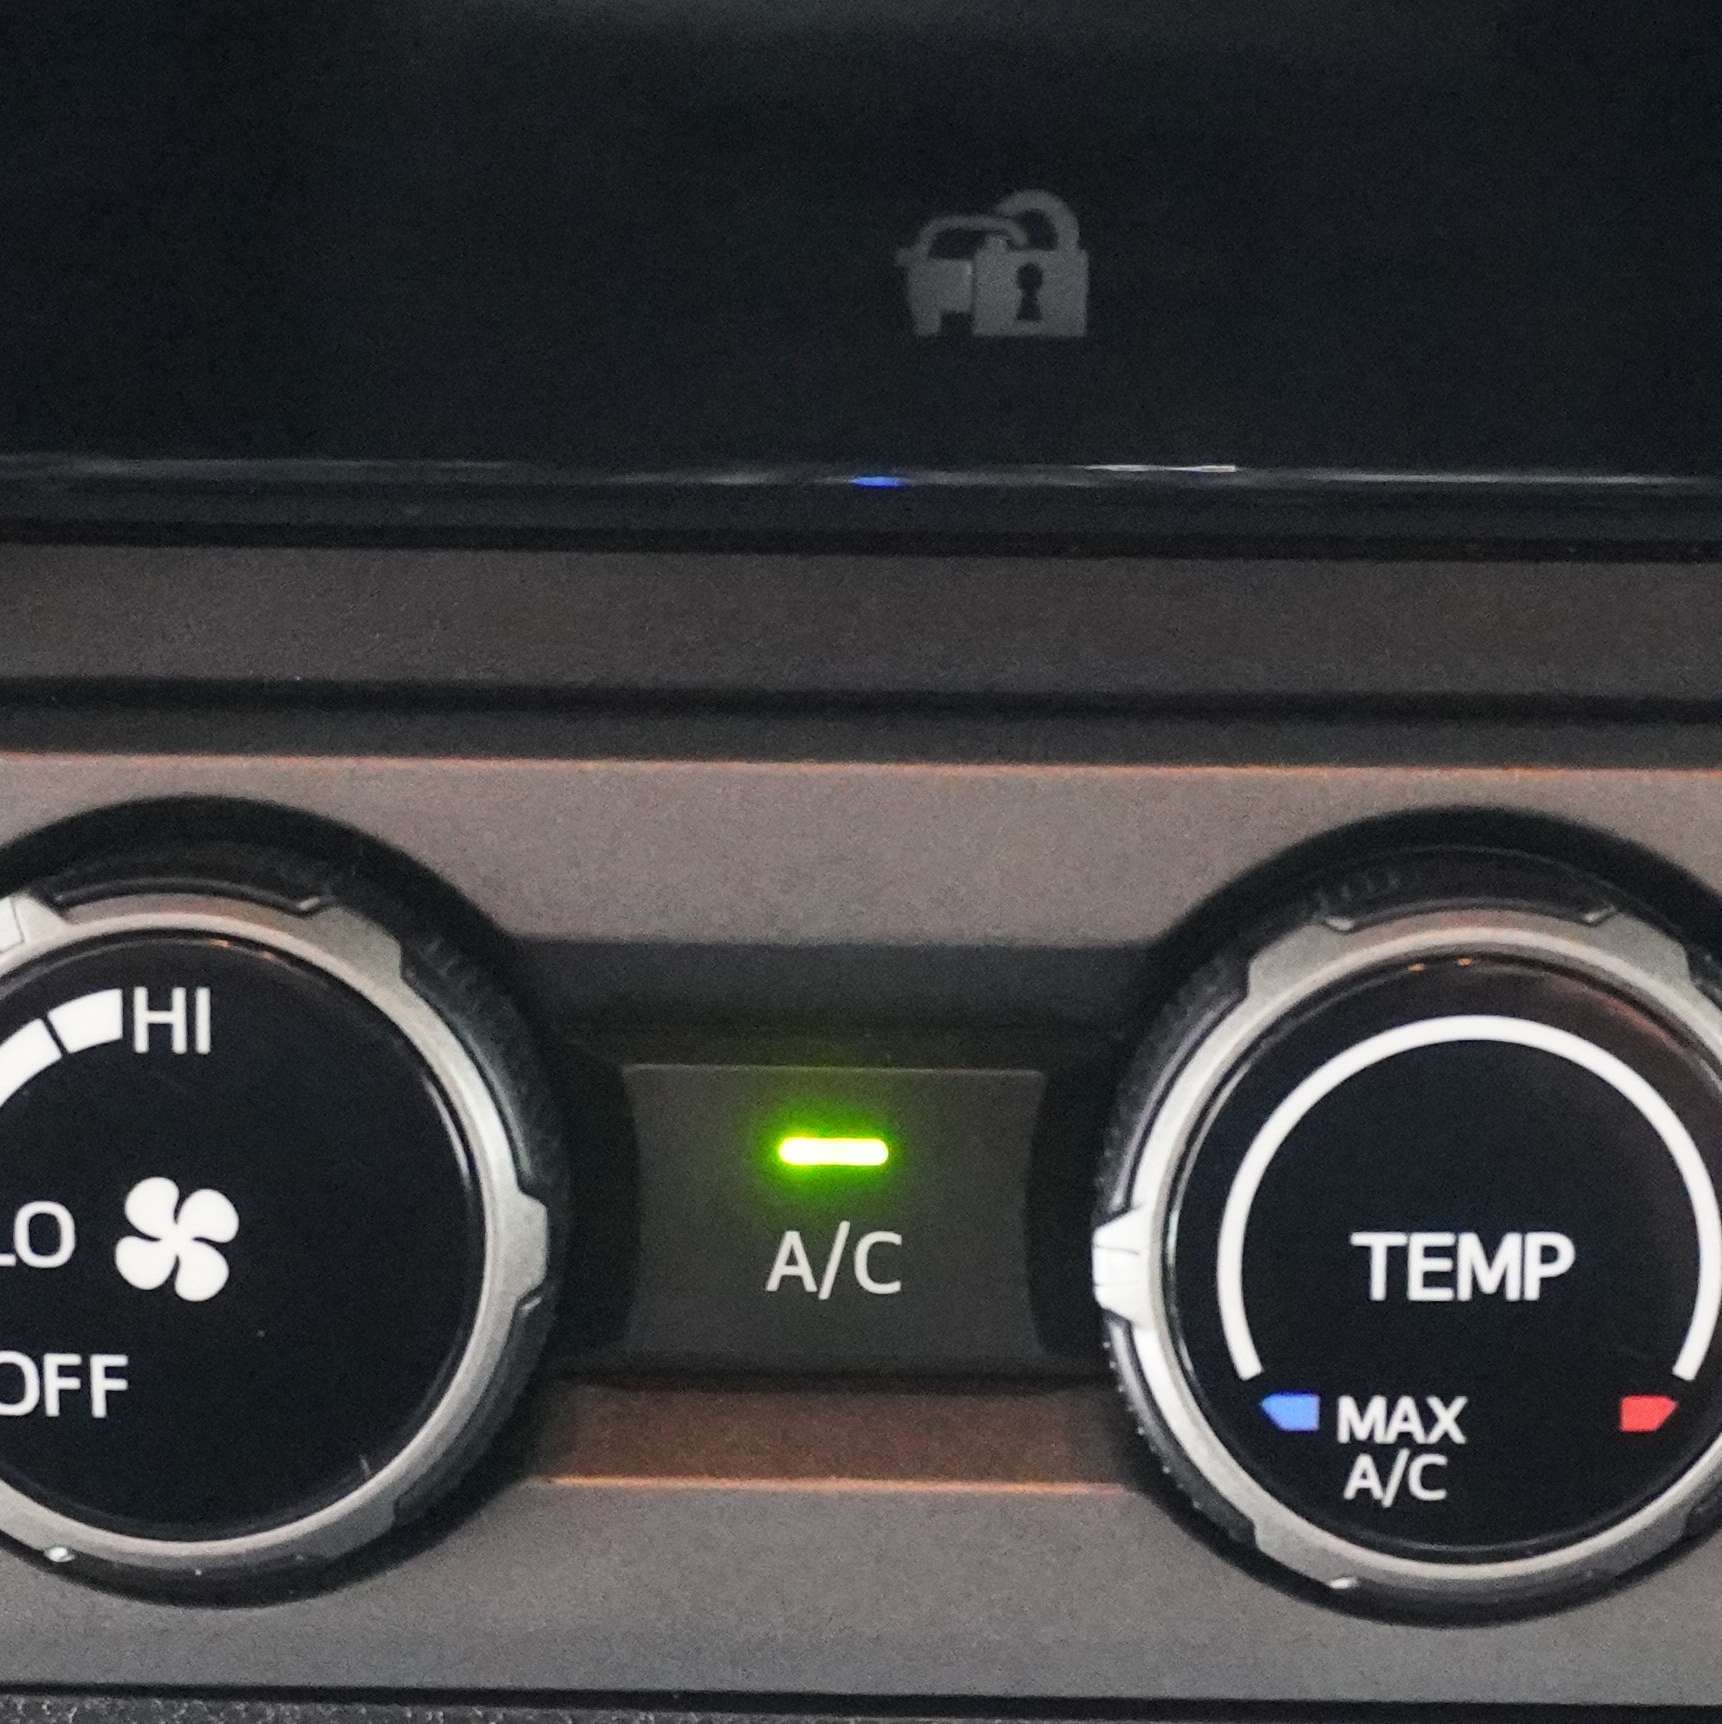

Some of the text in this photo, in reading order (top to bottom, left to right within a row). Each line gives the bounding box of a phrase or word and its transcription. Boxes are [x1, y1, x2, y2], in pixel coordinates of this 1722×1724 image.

[132, 986, 211, 1054] HI
[765, 1220, 903, 1300] A/C
[1350, 1231, 1576, 1302] TEMP
[1337, 1395, 1468, 1444] MAX
[1343, 1448, 1448, 1508] A/C
